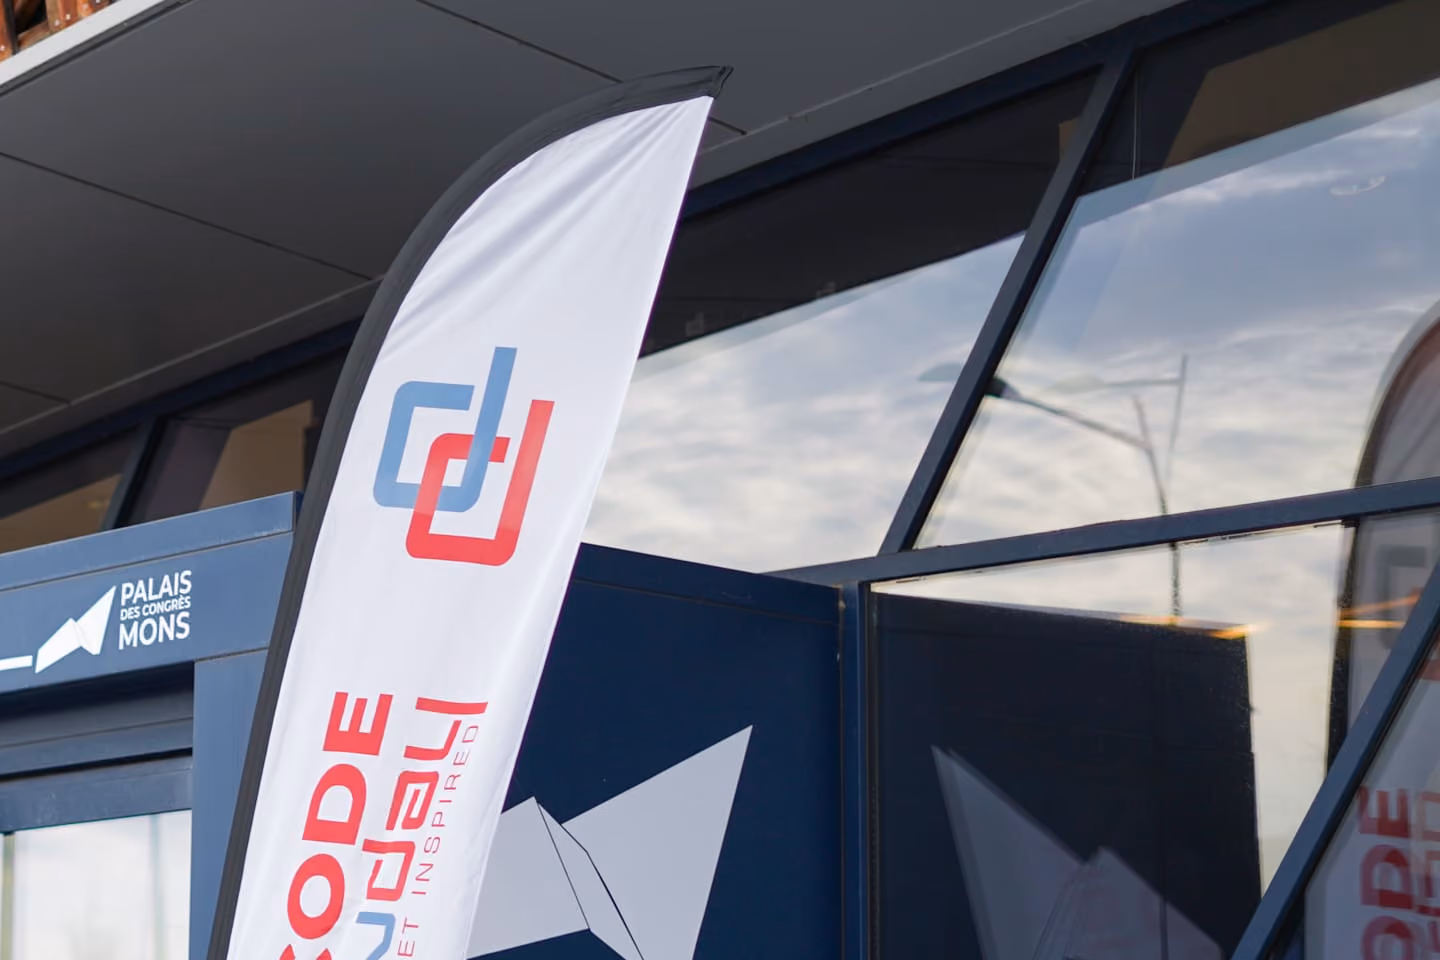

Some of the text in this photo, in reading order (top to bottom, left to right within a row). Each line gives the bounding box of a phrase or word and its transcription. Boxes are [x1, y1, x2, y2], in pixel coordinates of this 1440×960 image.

[120, 569, 192, 606] PALAIS
[120, 595, 191, 621] DES CONGRÈS
[118, 611, 191, 651] MONS
[411, 724, 481, 896] INSPIRED
